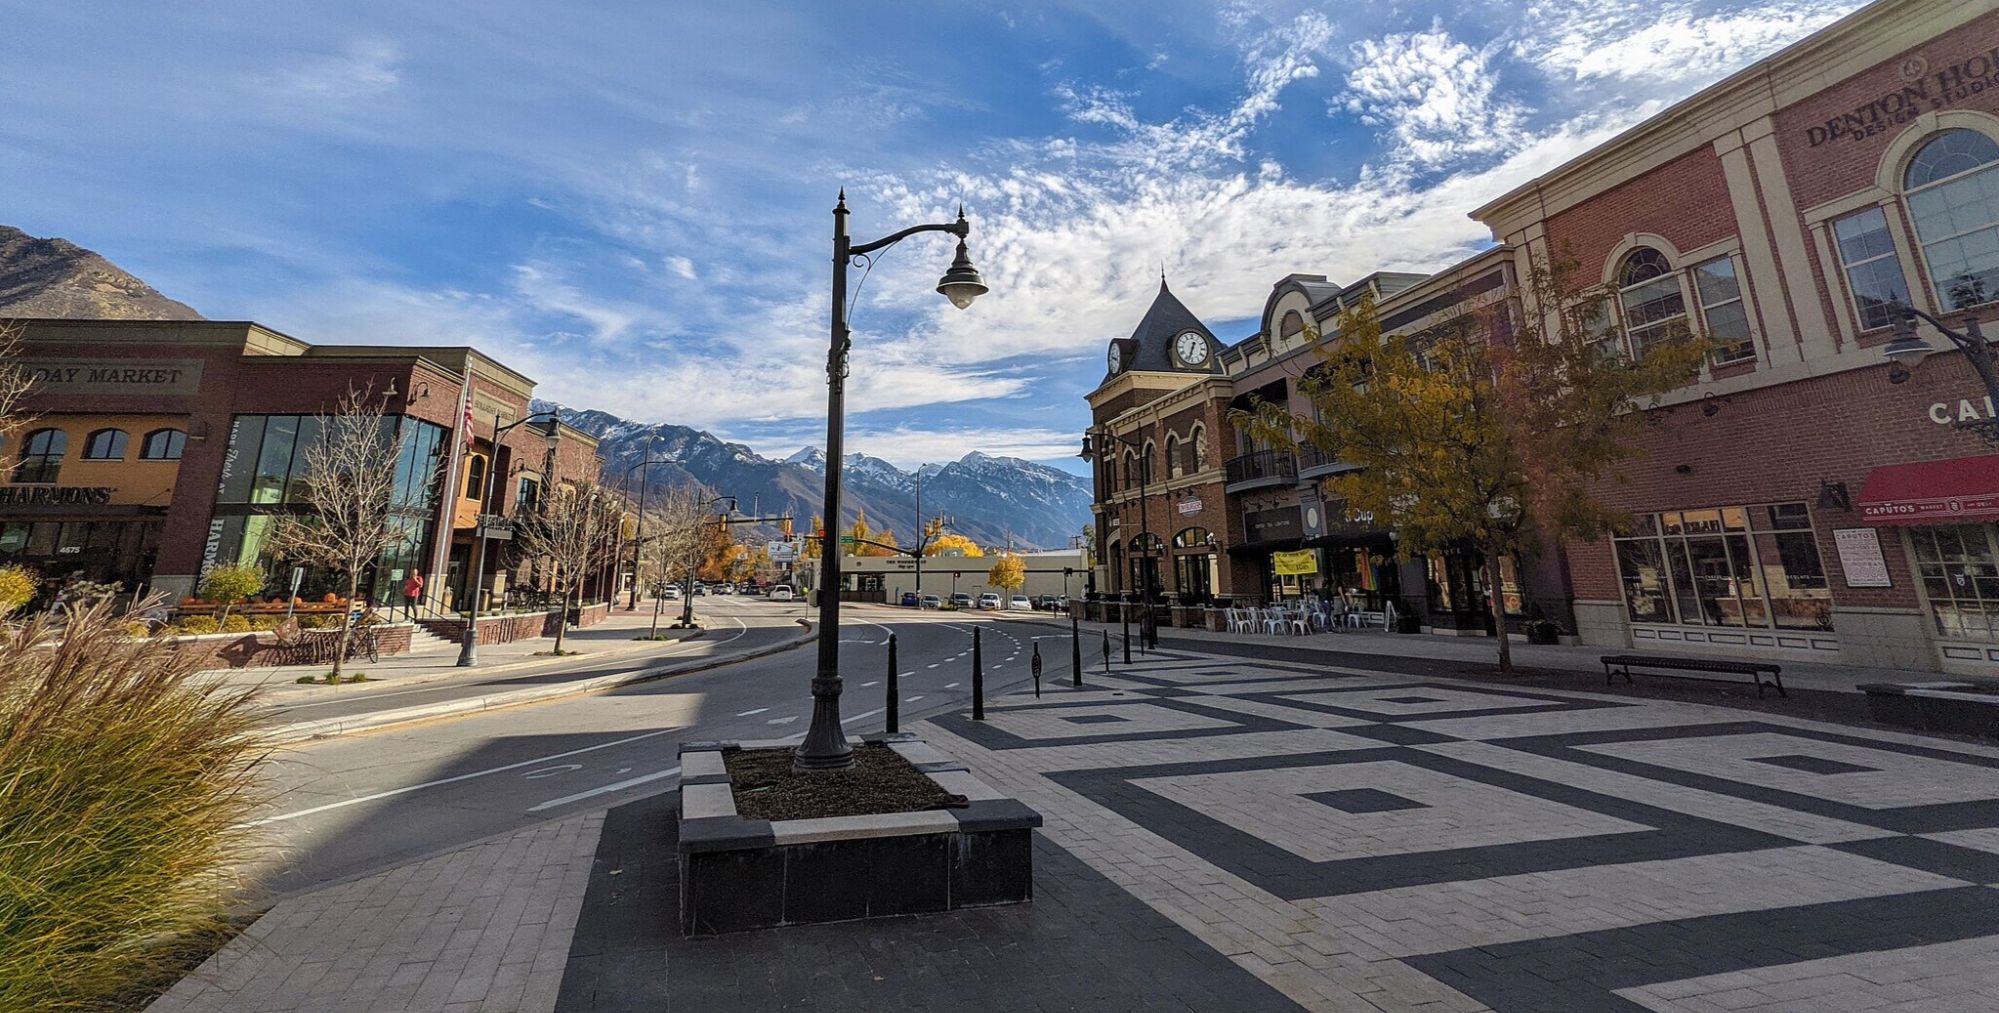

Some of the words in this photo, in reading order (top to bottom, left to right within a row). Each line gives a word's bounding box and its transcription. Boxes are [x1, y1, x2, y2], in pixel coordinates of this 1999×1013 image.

[1805, 81, 1927, 147] DENTON
[1852, 107, 1920, 141] DESIGN
[87, 368, 183, 384] MARKET
[228, 421, 241, 446] MADE
[0, 487, 111, 505] HARMONS
[218, 482, 226, 494] AT
